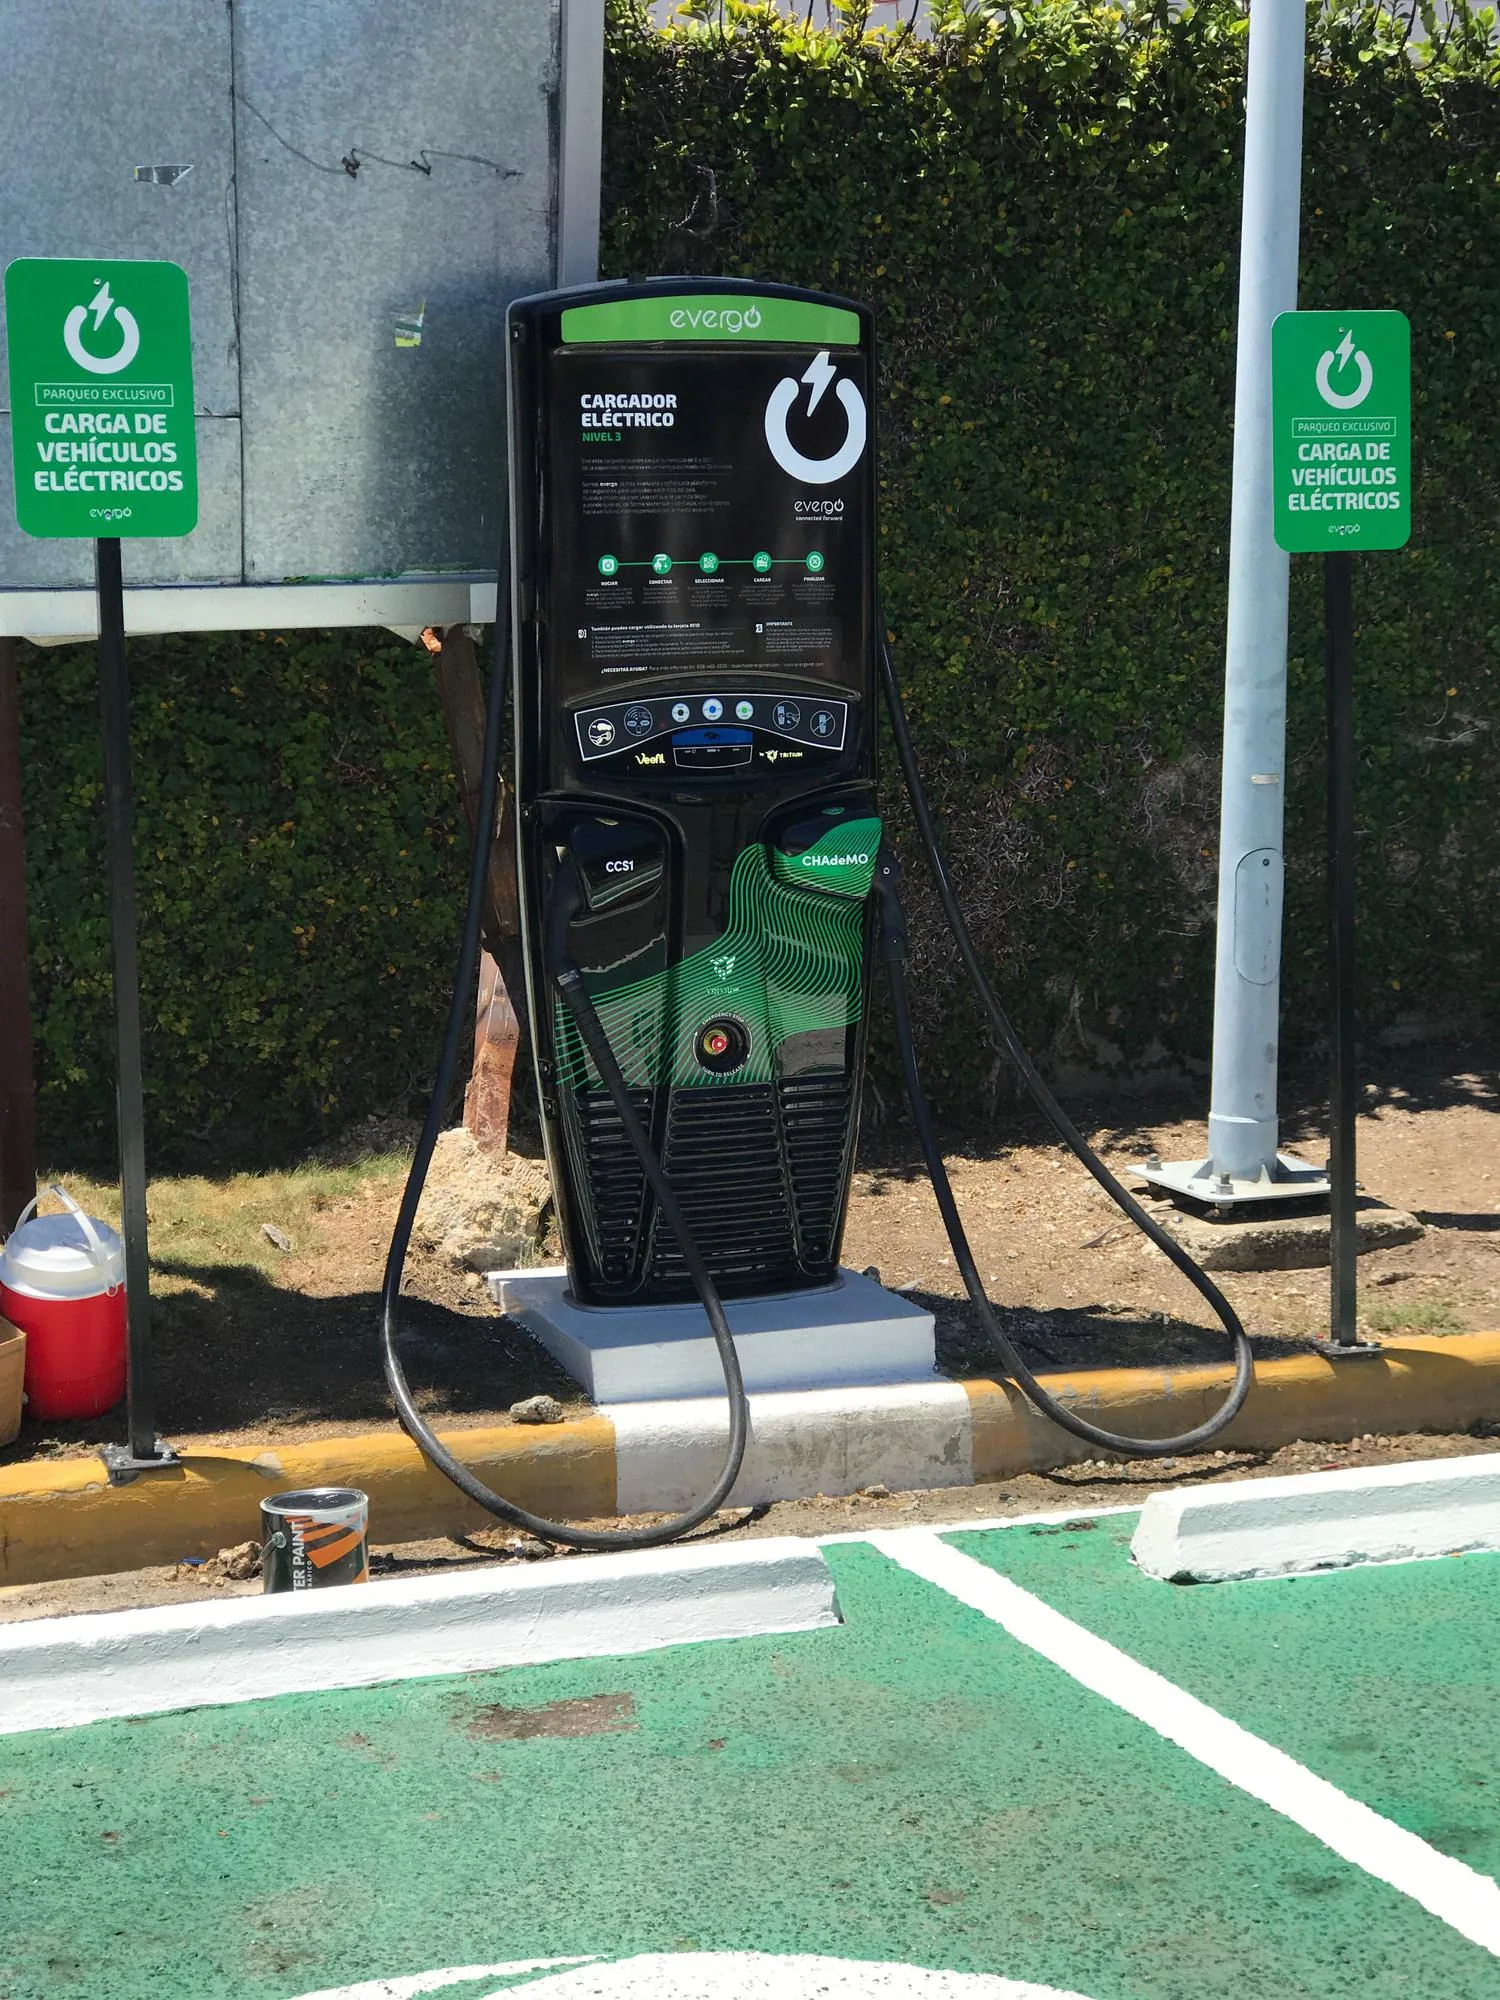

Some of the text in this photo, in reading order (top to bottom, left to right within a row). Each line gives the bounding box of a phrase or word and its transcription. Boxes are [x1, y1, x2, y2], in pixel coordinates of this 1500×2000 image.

[670, 305, 761, 332] evergo
[43, 389, 166, 401] PARQUEO EXCLUSIVO
[580, 394, 677, 408] CARGADOR
[44, 413, 167, 434] CARGA DE
[581, 409, 674, 427] ELÉCTRICO
[1298, 421, 1391, 433] PARQUEO EXCLUSIVO
[582, 432, 621, 442] NIVEL 3
[36, 437, 177, 463] VEHÍCULOS
[1298, 442, 1390, 461] CARGA DE
[34, 465, 184, 492] ELÉCTRICOS
[1291, 463, 1397, 486] VEHÍCULOS
[794, 498, 844, 515] evergo
[1288, 488, 1400, 511] ELÉCTRICOS
[605, 860, 634, 873] CCS1
[802, 853, 869, 867] CHAdeMO
[702, 1012, 745, 1025] EMERGENCY STOP
[702, 1066, 715, 1077] TURN
[723, 1064, 745, 1077] RELEASE
[291, 1522, 305, 1566] PAINT
